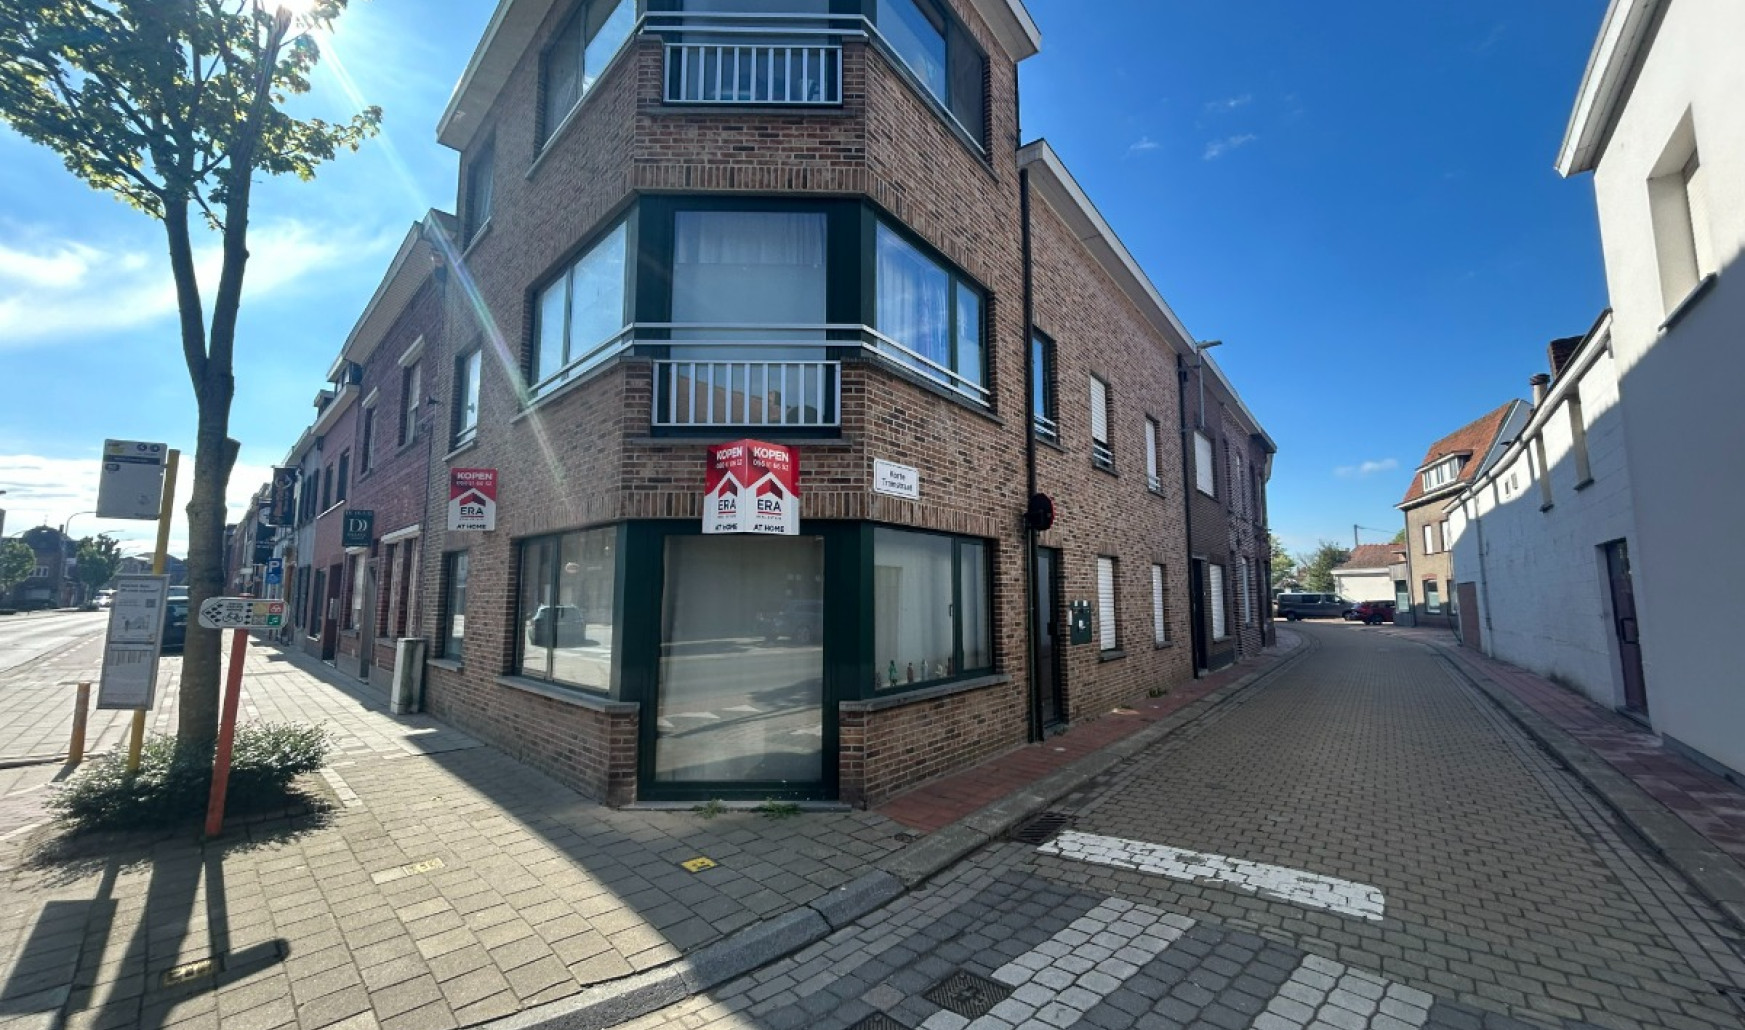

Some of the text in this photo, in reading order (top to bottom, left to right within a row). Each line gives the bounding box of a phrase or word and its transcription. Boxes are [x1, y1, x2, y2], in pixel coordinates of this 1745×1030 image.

[716, 446, 743, 461] KOPEN
[753, 446, 789, 463] KOPEN
[457, 472, 492, 480] KOPEN
[460, 507, 484, 515] ERA
[718, 499, 737, 511] ERA
[757, 499, 782, 512] ERA
[764, 525, 785, 533] HOME
[269, 561, 279, 573] P
